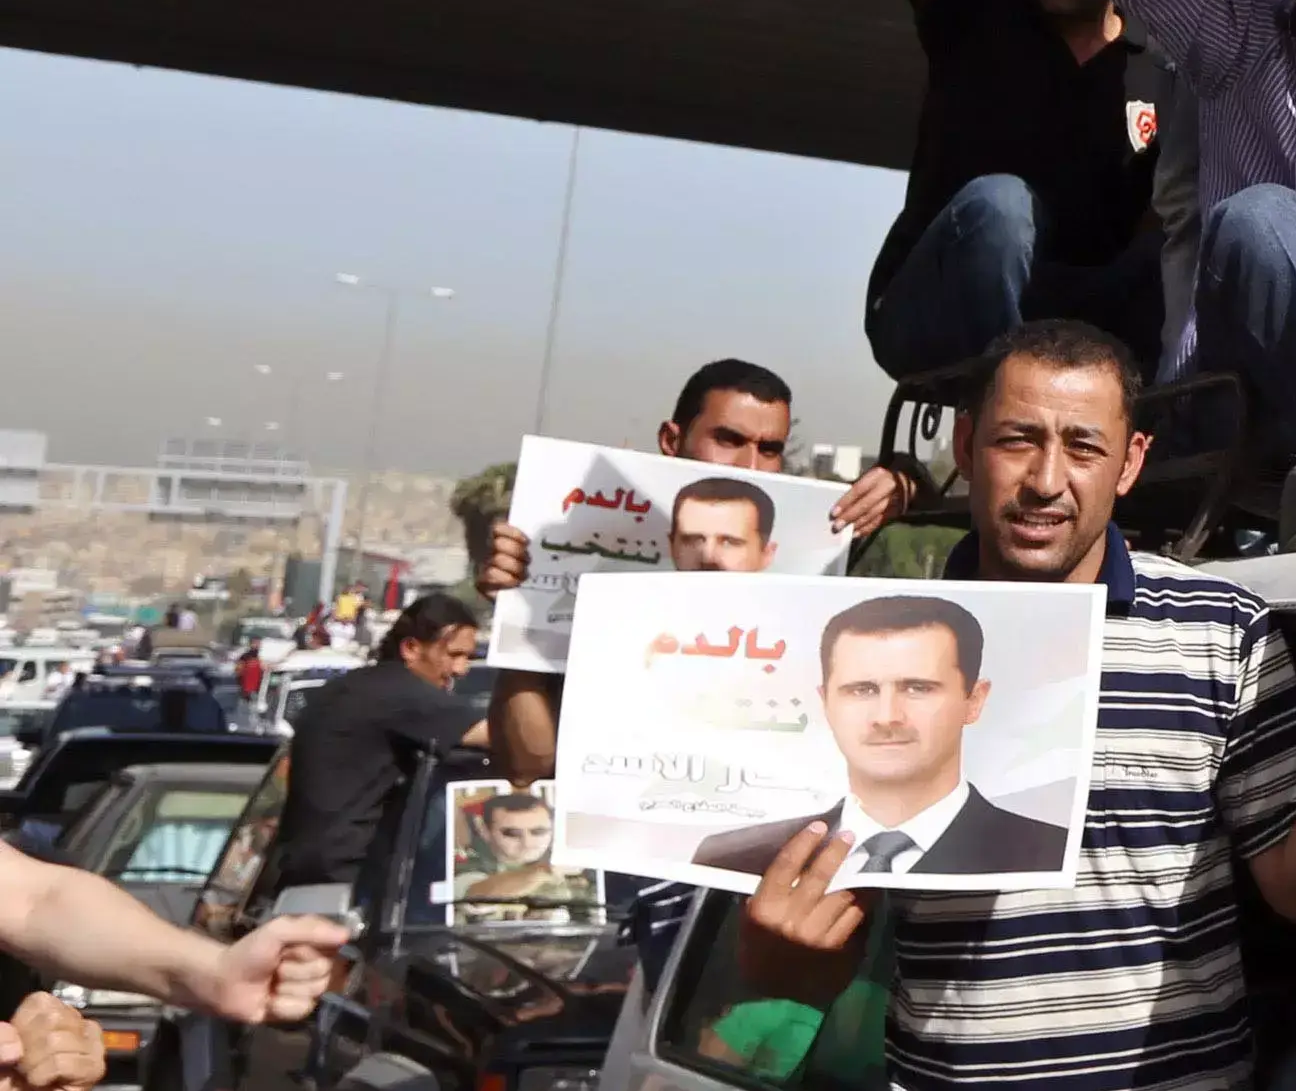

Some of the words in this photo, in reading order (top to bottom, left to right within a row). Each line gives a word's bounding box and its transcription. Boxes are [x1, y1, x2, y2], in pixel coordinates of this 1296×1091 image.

[562, 487, 652, 523] بالدم
[541, 532, 661, 564] ننتخب
[644, 623, 787, 674] بالدم
